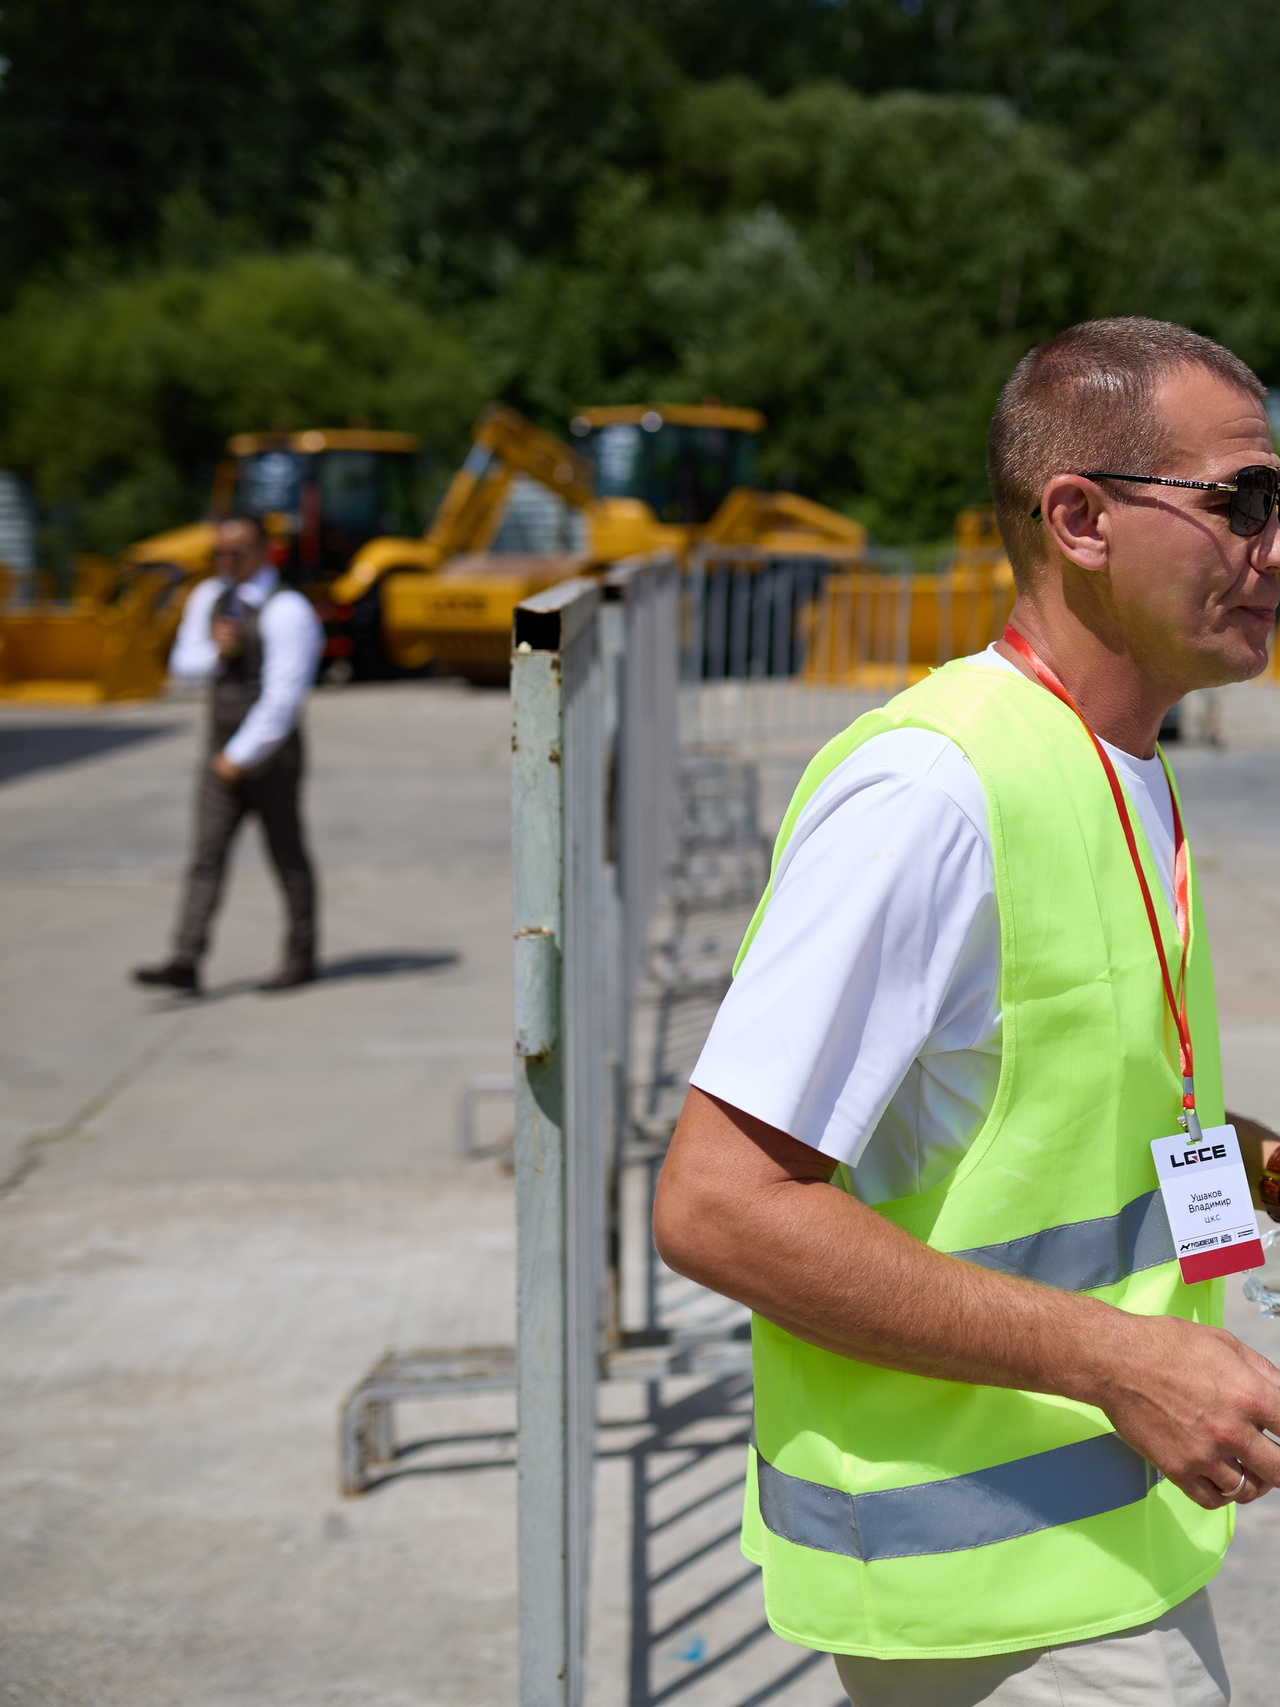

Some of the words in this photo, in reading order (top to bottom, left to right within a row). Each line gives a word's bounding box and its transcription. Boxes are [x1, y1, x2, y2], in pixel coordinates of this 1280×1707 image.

[1170, 1144, 1226, 1167] LGCE
[1190, 1190, 1223, 1203] Ушаков
[1188, 1198, 1232, 1213] Владимир
